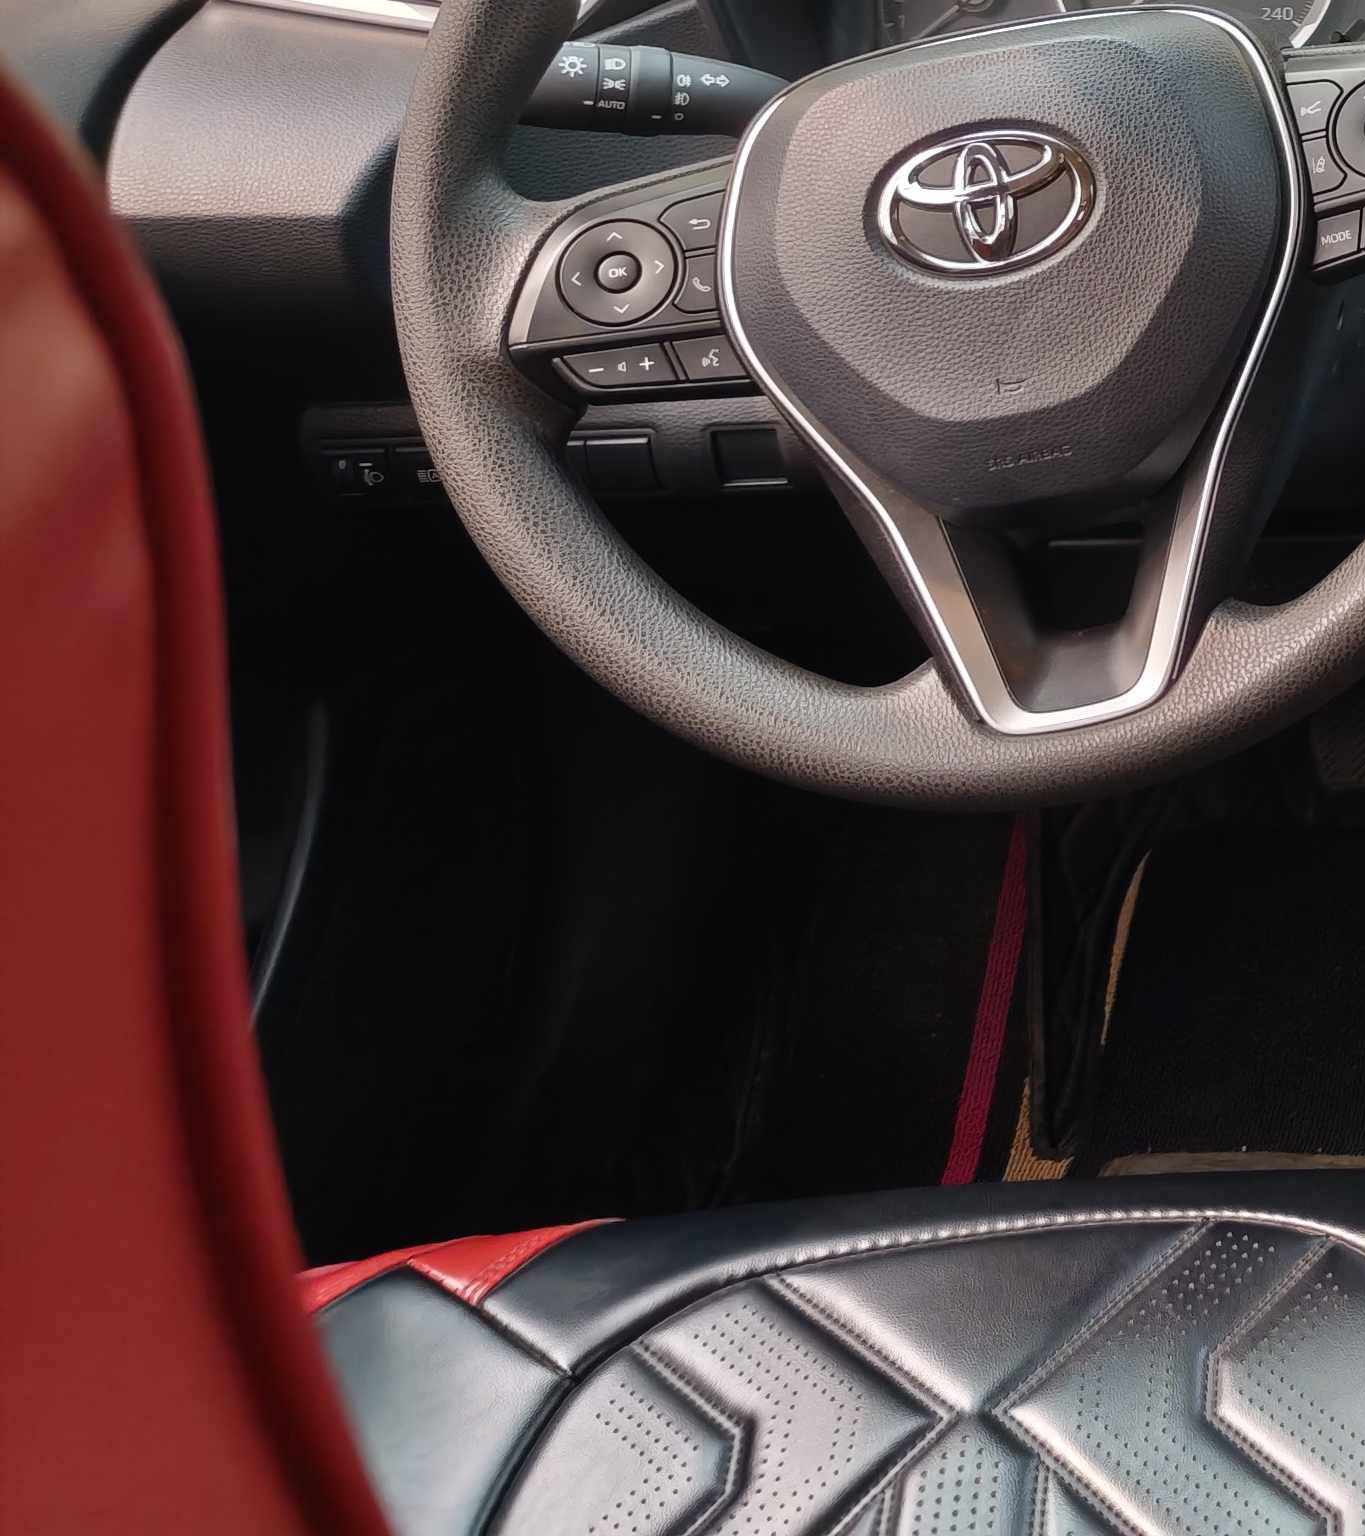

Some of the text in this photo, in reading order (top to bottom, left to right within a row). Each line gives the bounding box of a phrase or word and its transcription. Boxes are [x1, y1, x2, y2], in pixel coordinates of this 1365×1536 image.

[1262, 7, 1294, 21] 240
[597, 99, 626, 110] AUTO
[1321, 228, 1353, 245] MODE
[608, 268, 628, 279] OK
